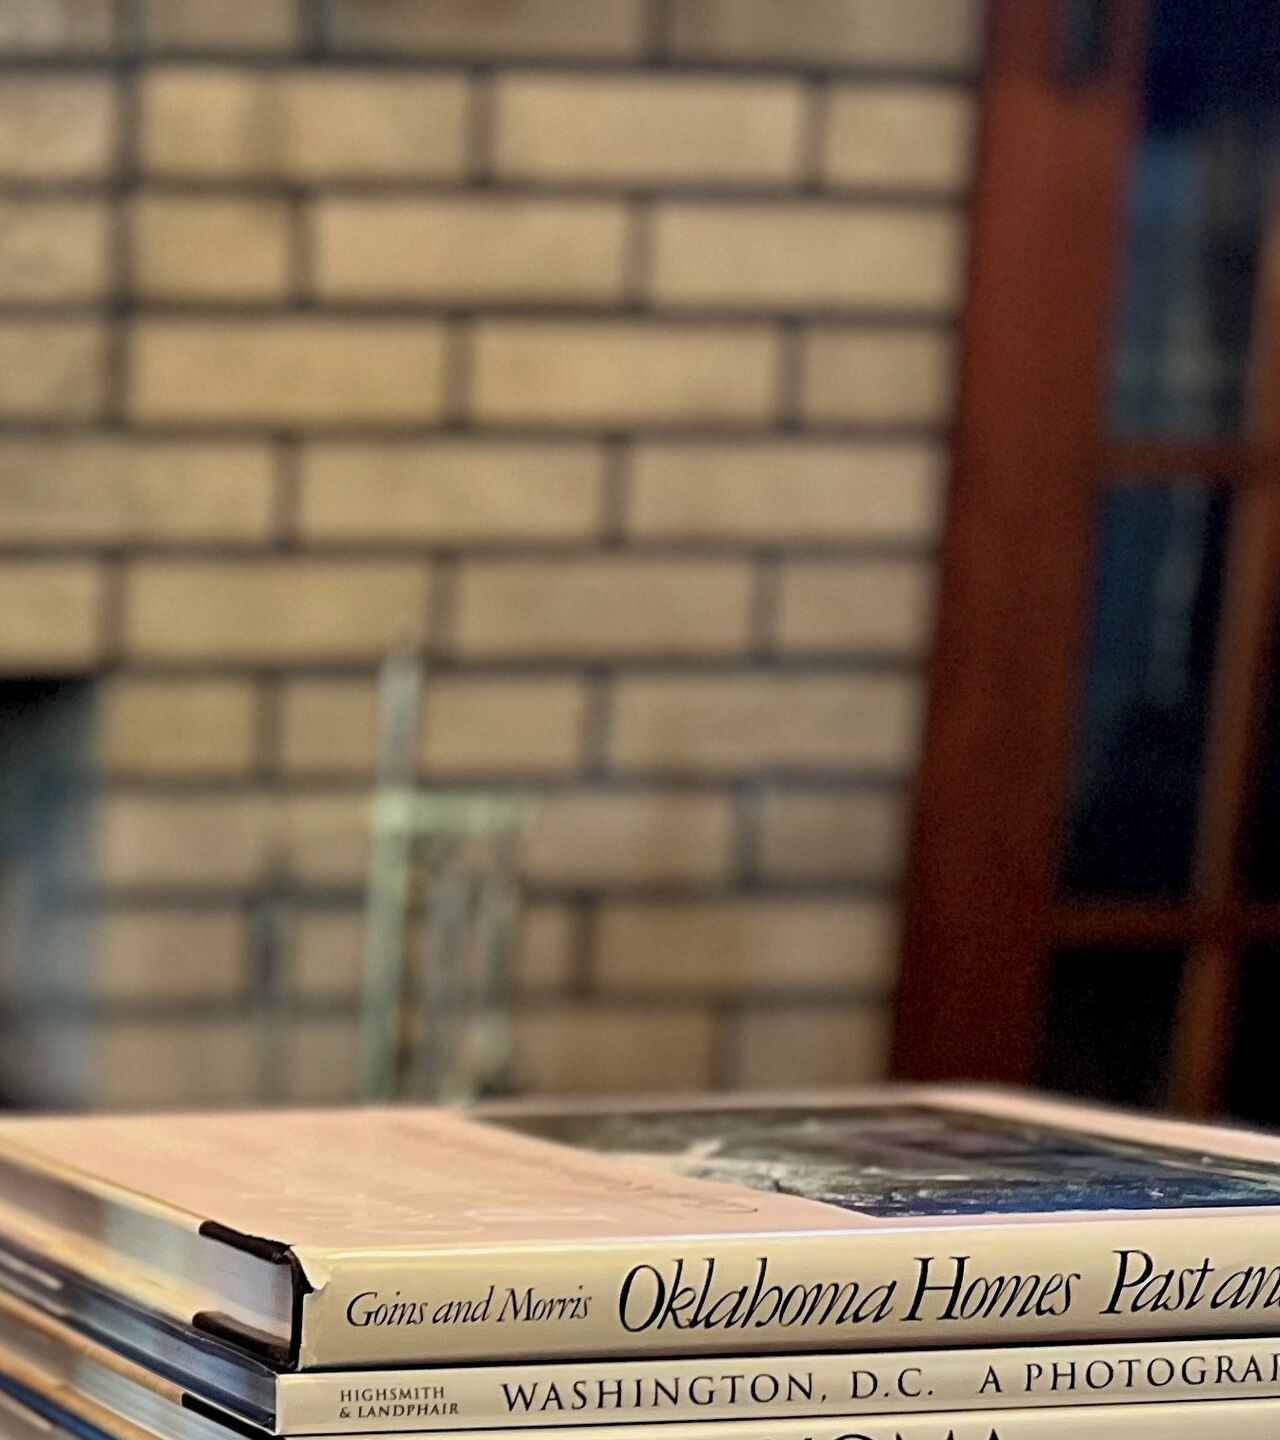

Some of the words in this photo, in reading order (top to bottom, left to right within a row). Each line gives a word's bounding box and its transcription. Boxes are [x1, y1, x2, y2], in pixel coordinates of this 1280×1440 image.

[346, 1290, 429, 1328] Goins
[432, 1285, 495, 1325] and
[496, 1285, 592, 1323] Morris
[619, 1257, 898, 1333] Oklahoma
[899, 1255, 1081, 1322] Homes
[1098, 1249, 1216, 1315] Past
[1210, 1265, 1280, 1310] an
[340, 1386, 446, 1403] HIGHSMITH
[500, 1370, 827, 1413] WASHINGTON,
[850, 1367, 934, 1400] D.C.
[978, 1364, 1003, 1394] A
[339, 1407, 351, 1420] &
[357, 1402, 460, 1418] LANDPHAIR
